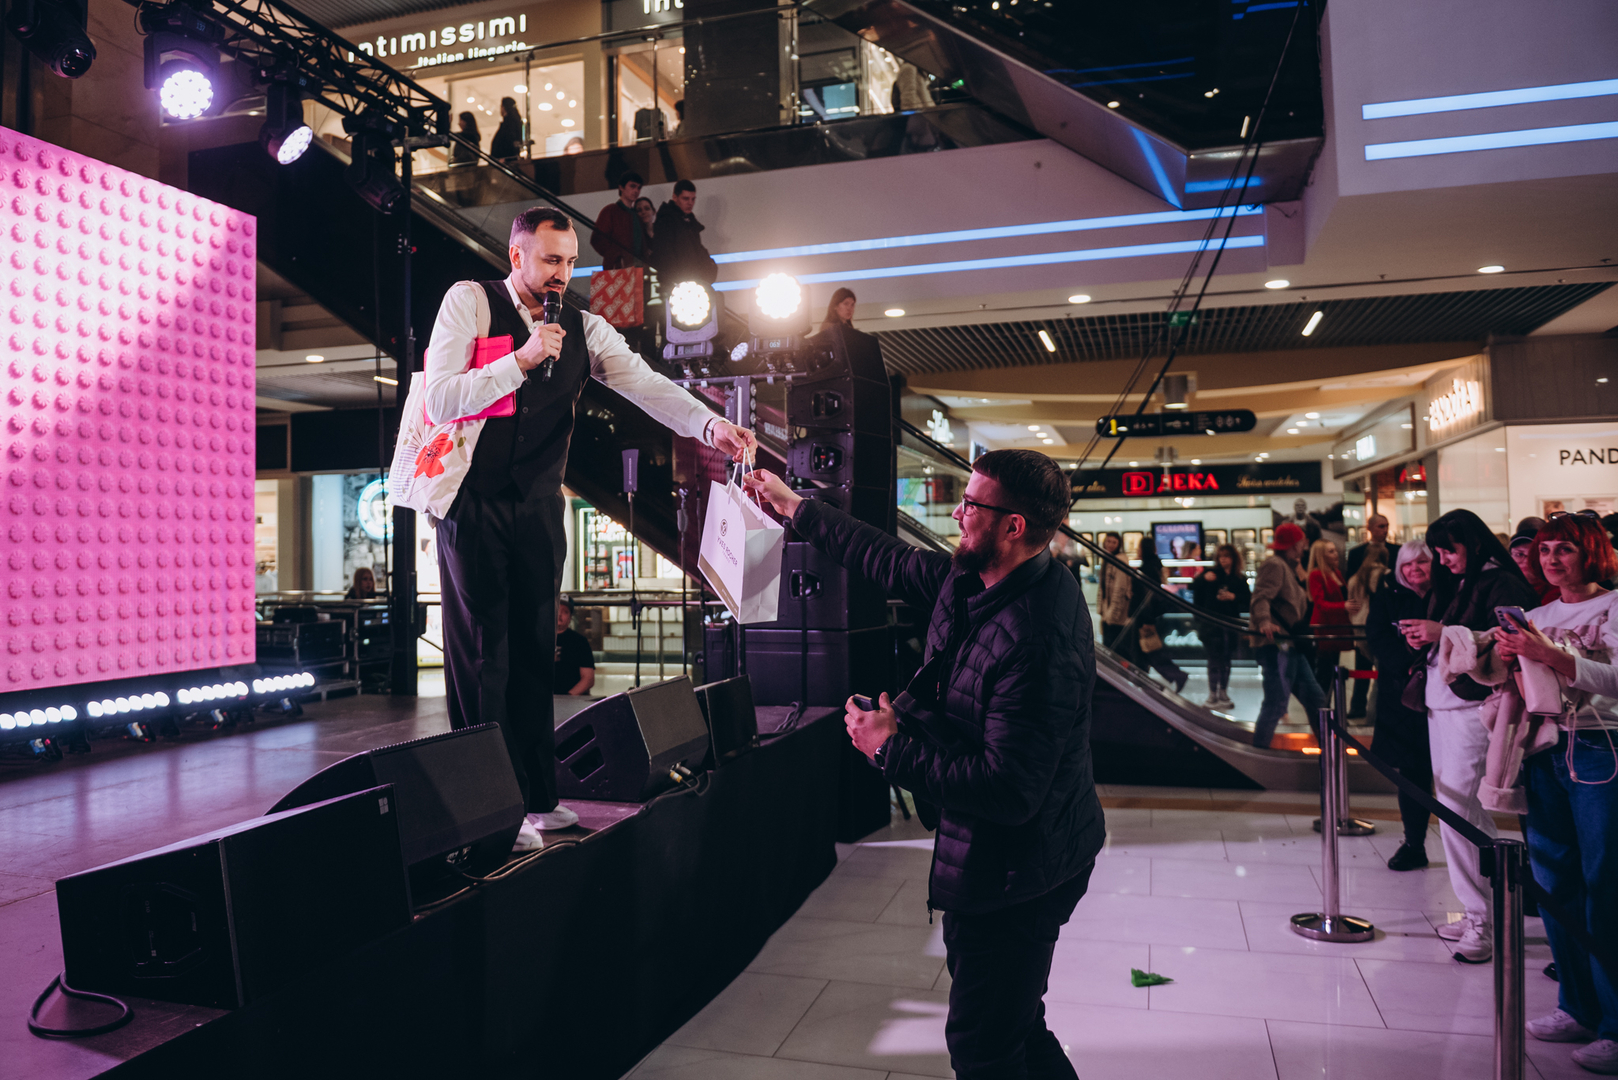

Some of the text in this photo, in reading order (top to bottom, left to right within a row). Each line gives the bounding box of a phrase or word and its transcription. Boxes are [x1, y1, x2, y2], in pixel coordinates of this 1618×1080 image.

[417, 53, 465, 67] Italian
[1560, 448, 1618, 465] PAND
[1157, 473, 1219, 492] ДЕКА
[717, 536, 738, 567] YVES ROCHER
